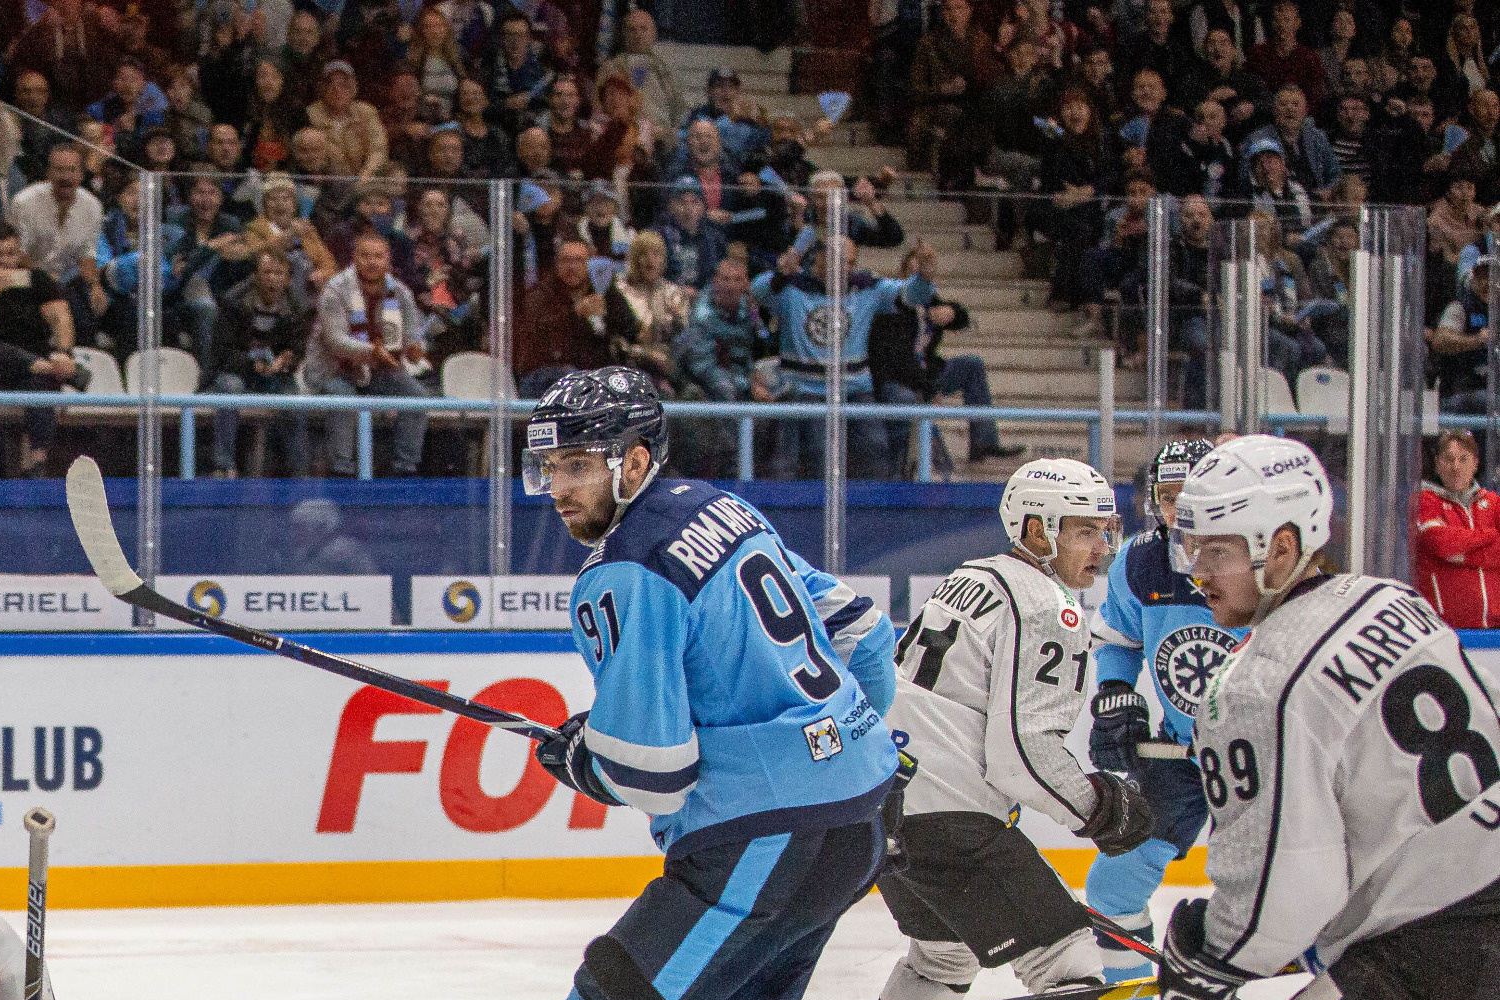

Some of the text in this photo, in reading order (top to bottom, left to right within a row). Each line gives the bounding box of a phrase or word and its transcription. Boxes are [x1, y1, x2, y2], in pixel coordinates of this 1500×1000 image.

[1021, 500, 1046, 508] CCM
[243, 590, 361, 613] ERIELL
[576, 589, 621, 663] 91
[1174, 628, 1225, 644] HOCKEY
[1034, 641, 1090, 694] 21
[1200, 738, 1261, 809] 89
